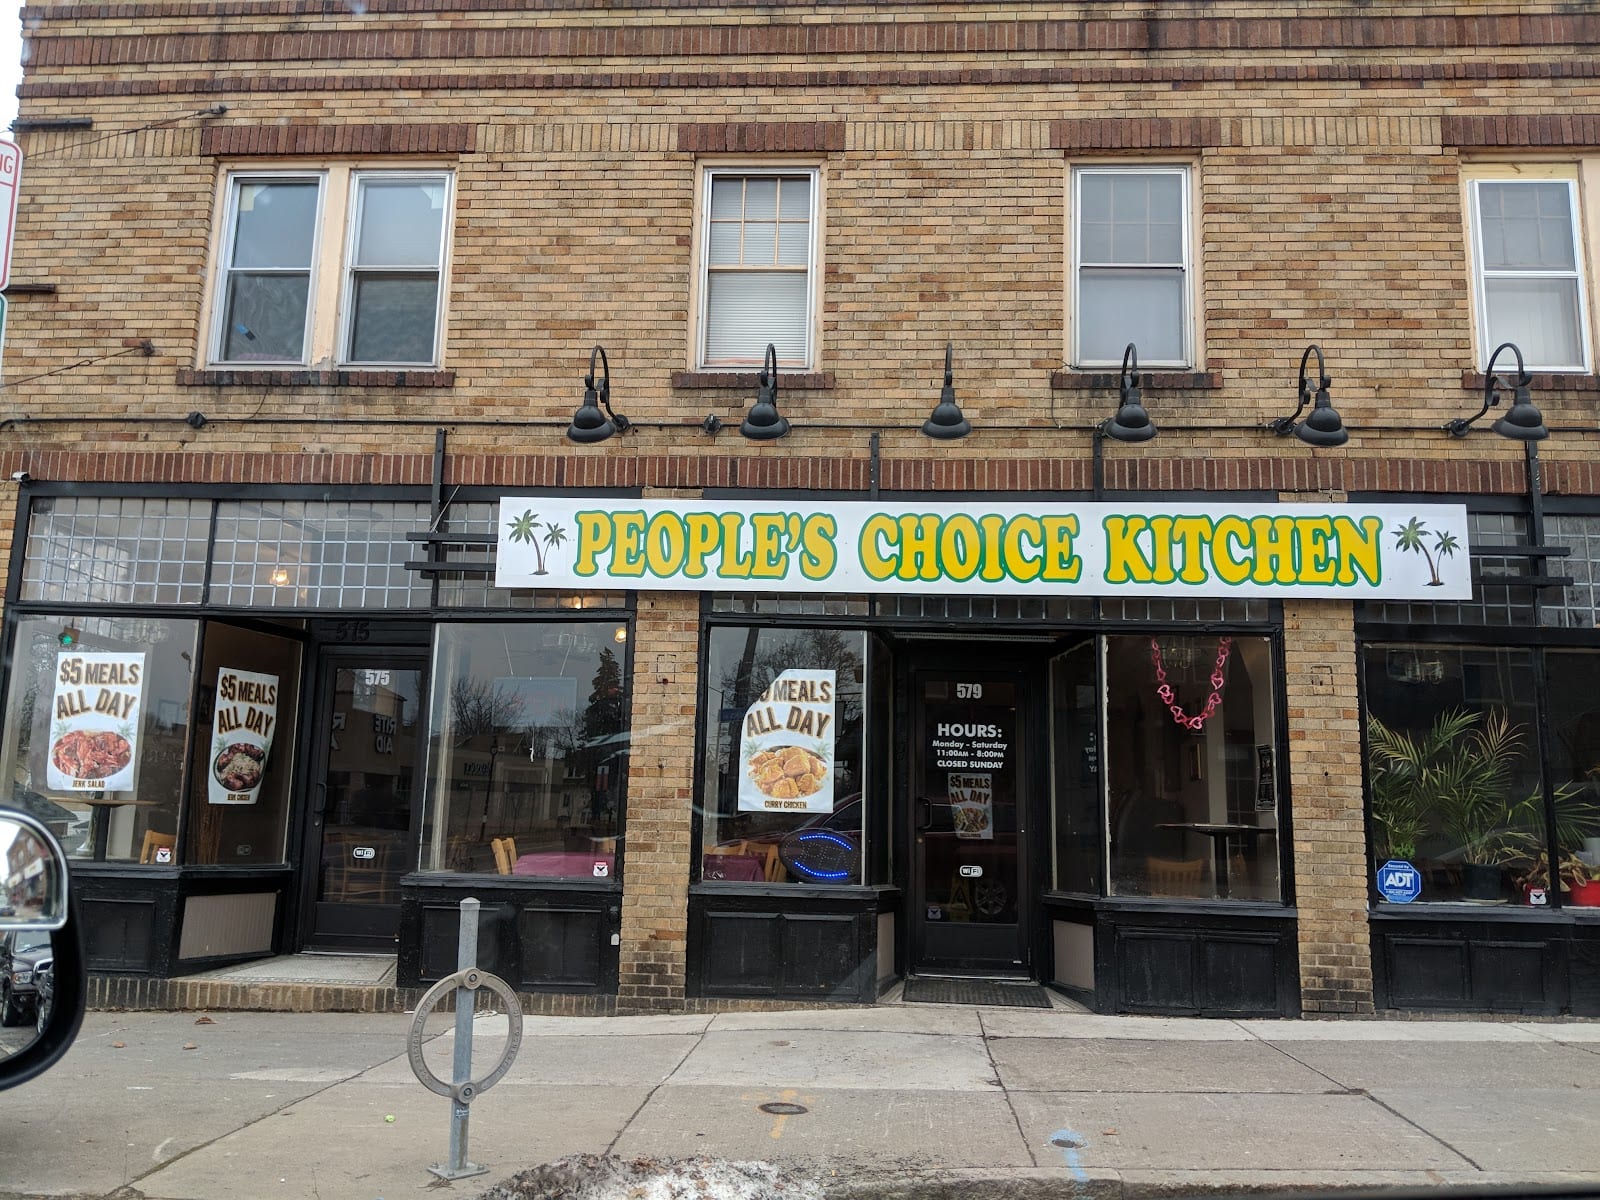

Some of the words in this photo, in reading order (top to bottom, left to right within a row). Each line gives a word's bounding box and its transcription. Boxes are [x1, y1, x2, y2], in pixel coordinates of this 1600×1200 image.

[573, 509, 838, 581] PEOPLE'S
[858, 512, 1082, 584] CHOICE
[1103, 514, 1384, 587] KITCHEN
[59, 657, 83, 685] $5
[85, 662, 140, 686] MEALS
[365, 670, 390, 686] 575
[219, 674, 237, 702] $5
[237, 678, 276, 706] MEALS
[774, 679, 833, 703] MEALS
[956, 683, 983, 699] 579
[56, 689, 91, 720] ALL
[94, 687, 137, 720] DAY
[218, 707, 243, 734] ALL
[244, 706, 274, 738] DAY
[746, 705, 784, 738] ALL
[786, 705, 831, 739] DAY
[937, 722, 1003, 738] HOURS:
[932, 740, 964, 749] Monday
[971, 741, 1008, 750] Saturday
[936, 760, 968, 768] CLOSED
[969, 760, 1004, 769] SUNDAY
[950, 775, 962, 789] $5
[962, 777, 990, 789] MEALS
[764, 800, 783, 809] CURRY
[783, 800, 807, 809] CHICKEN
[950, 790, 968, 805] ALL
[969, 789, 990, 805] DAY
[1385, 872, 1413, 888] ADT
